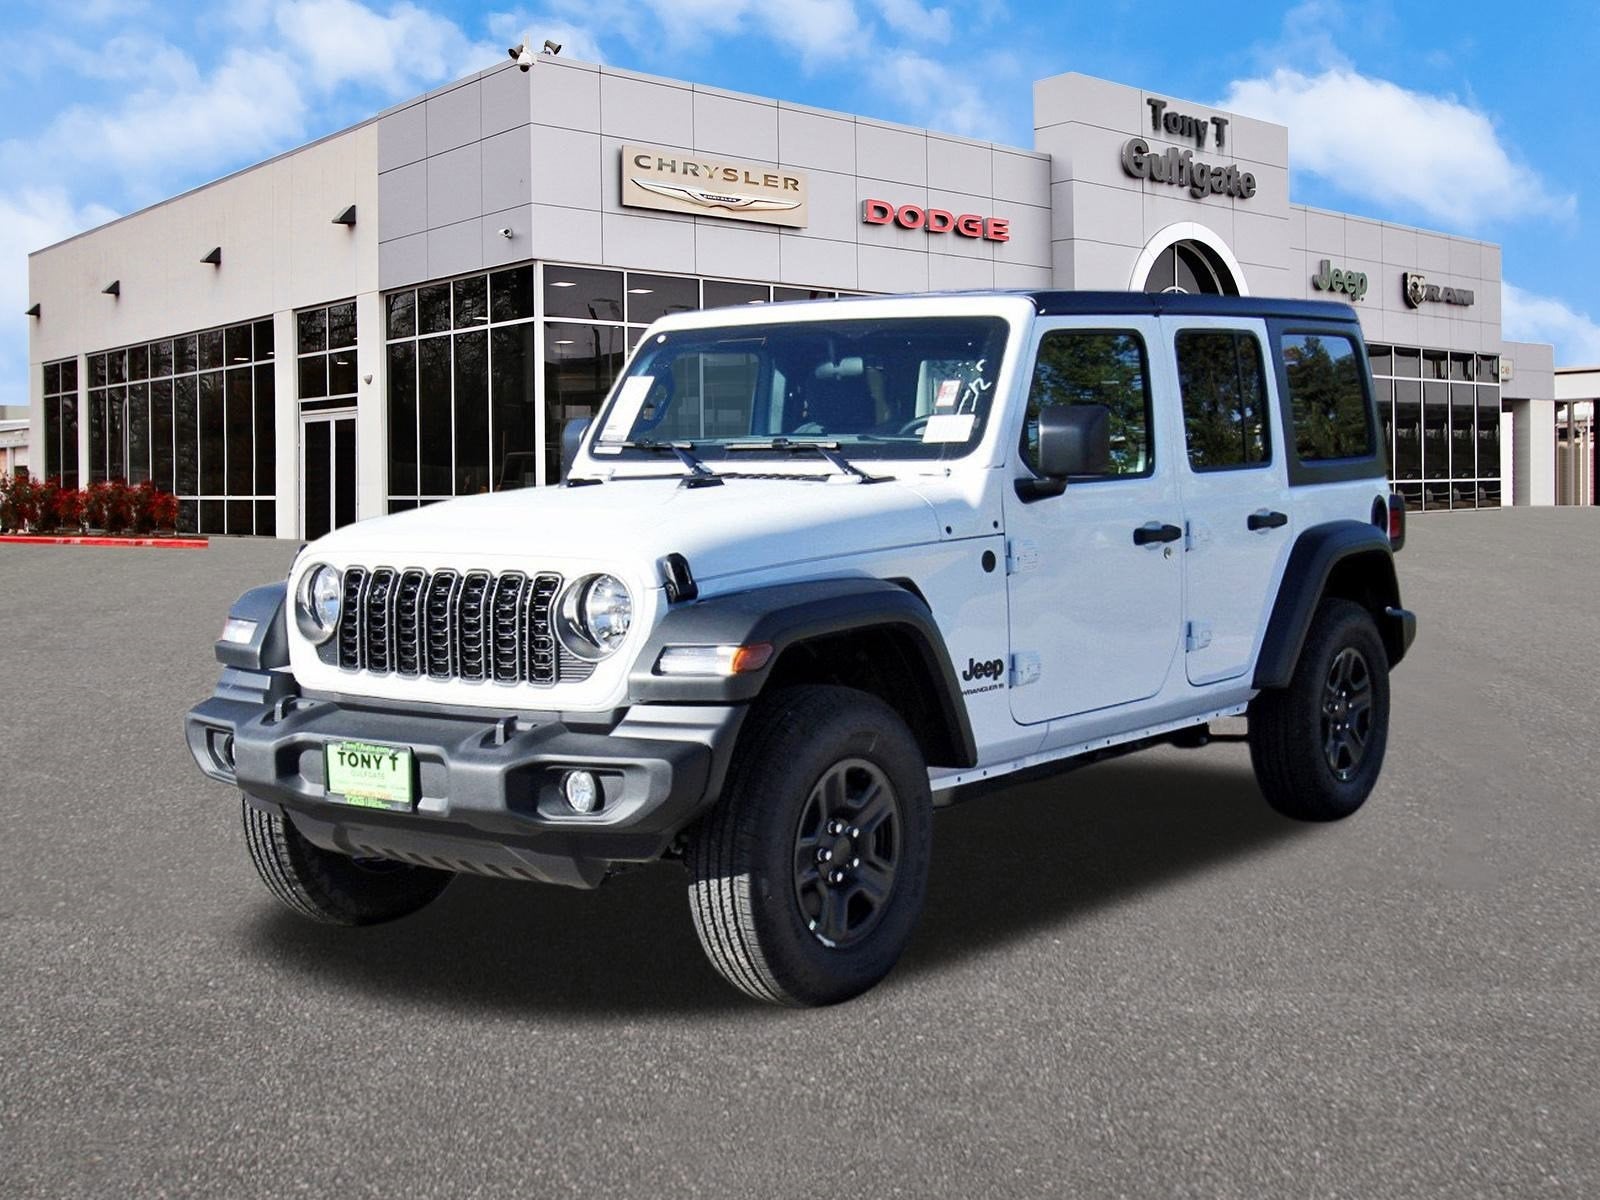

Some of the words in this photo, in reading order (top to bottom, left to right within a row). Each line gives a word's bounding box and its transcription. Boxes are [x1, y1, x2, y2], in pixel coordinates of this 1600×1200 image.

[1146, 98, 1208, 148] Tony
[1211, 116, 1229, 148] T
[633, 154, 800, 192] CHRYSLER
[1121, 137, 1257, 199] Gulfgate
[863, 199, 1010, 242] DODGE
[1312, 259, 1368, 301] Jeep
[1425, 284, 1475, 306] RAM
[962, 658, 1004, 681] Jeep
[337, 752, 383, 770] TONY
[389, 754, 398, 771] T
